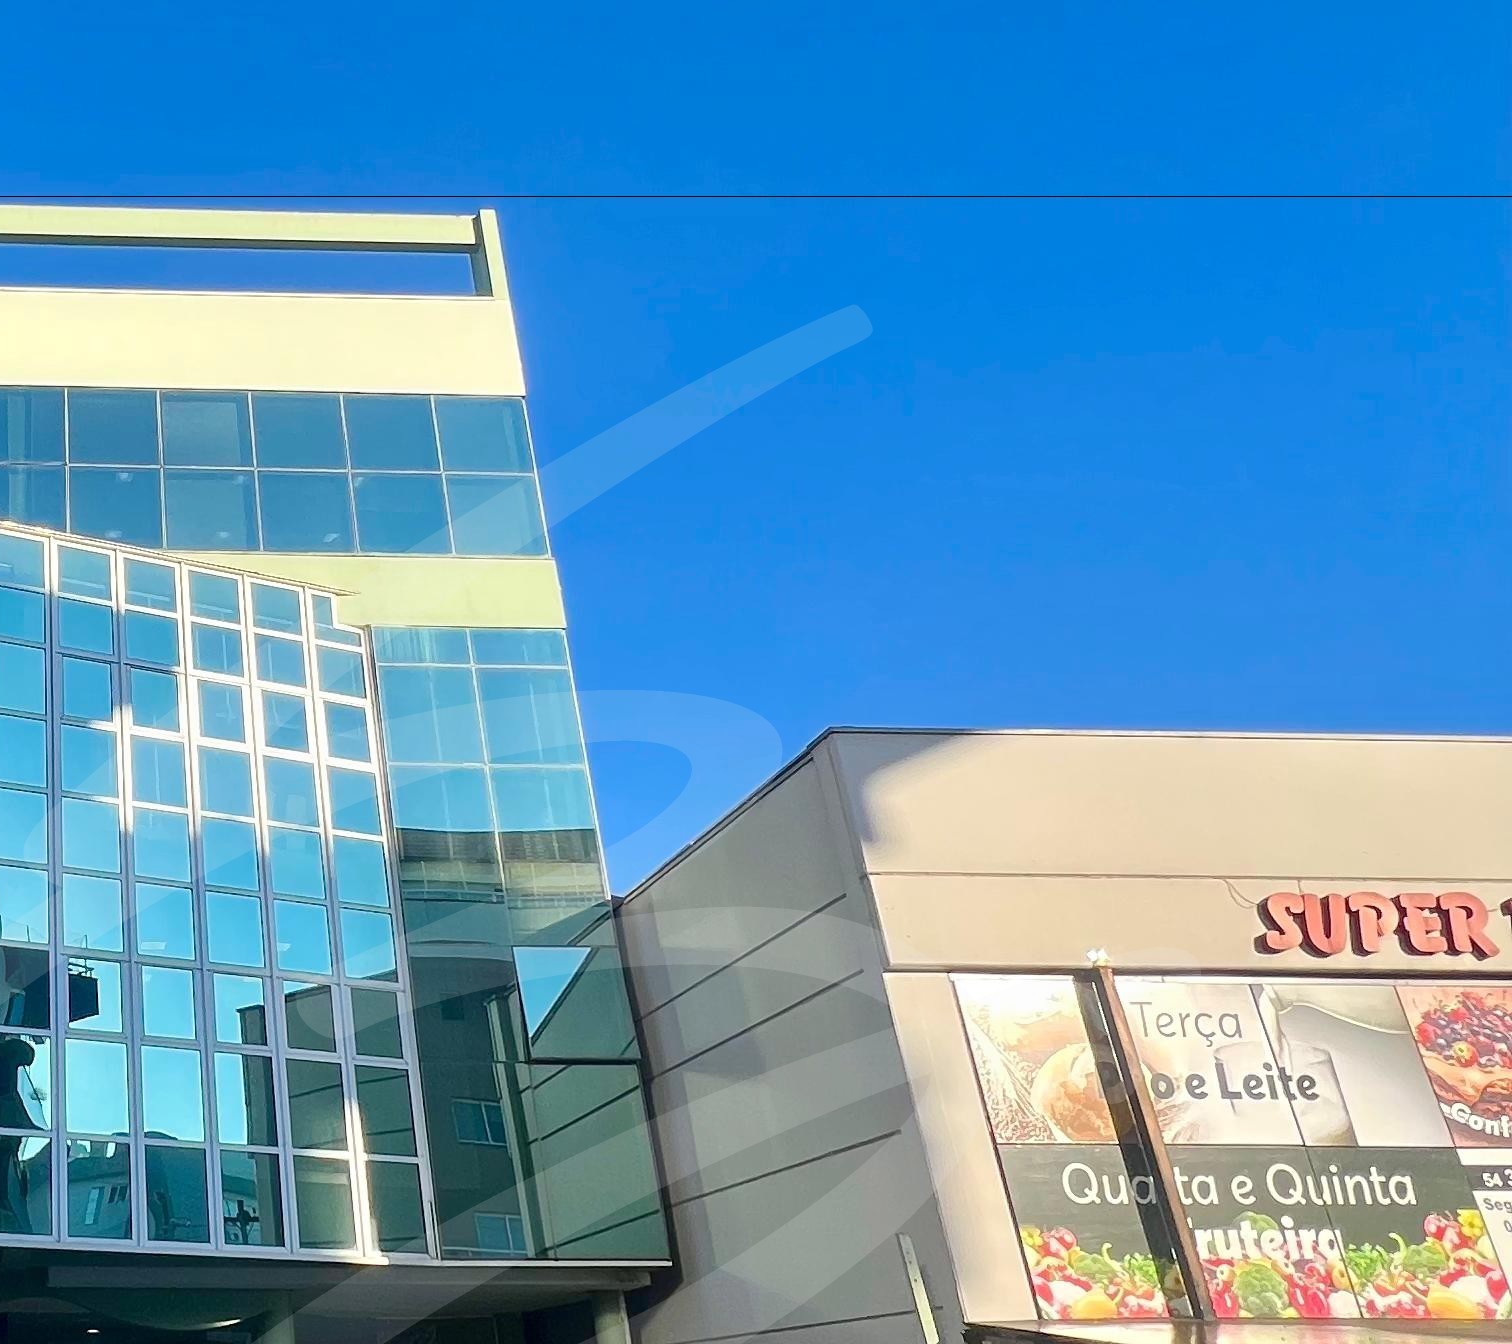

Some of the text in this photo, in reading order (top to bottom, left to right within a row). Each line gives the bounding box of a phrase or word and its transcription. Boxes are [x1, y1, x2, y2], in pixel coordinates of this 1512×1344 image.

[1254, 892, 1501, 961] SUPER
[1129, 1001, 1243, 1047] Terça
[1185, 1073, 1208, 1100] e
[1215, 1062, 1320, 1101] Leite
[1062, 1162, 1418, 1207] Quata e Quinta
[1186, 1216, 1345, 1261] ruteira
